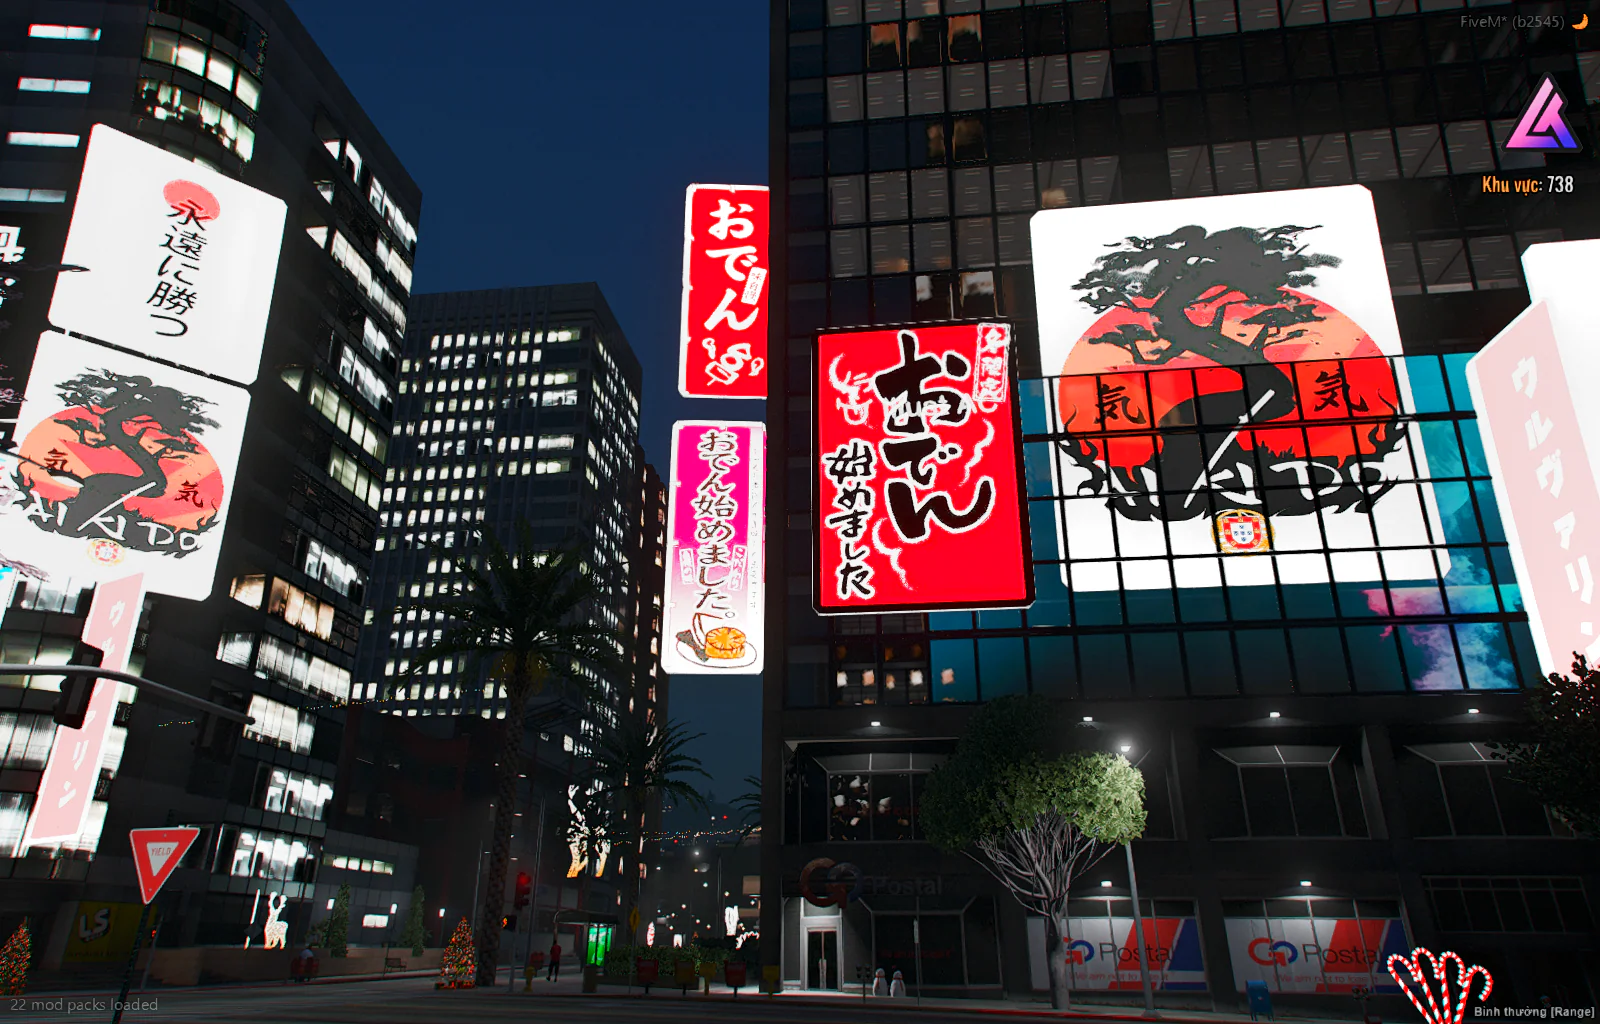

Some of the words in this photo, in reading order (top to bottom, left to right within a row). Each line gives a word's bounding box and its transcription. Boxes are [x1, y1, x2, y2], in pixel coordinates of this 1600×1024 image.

[146, 198, 208, 338] 永遠に勝つ
[703, 199, 760, 331] おでん
[1094, 384, 1146, 425] 気
[1313, 369, 1368, 412] 気
[174, 480, 203, 508] 気
[823, 439, 876, 600] 始めました
[150, 847, 172, 857] YIELD
[872, 875, 943, 896] Postal
[79, 907, 111, 940] LS
